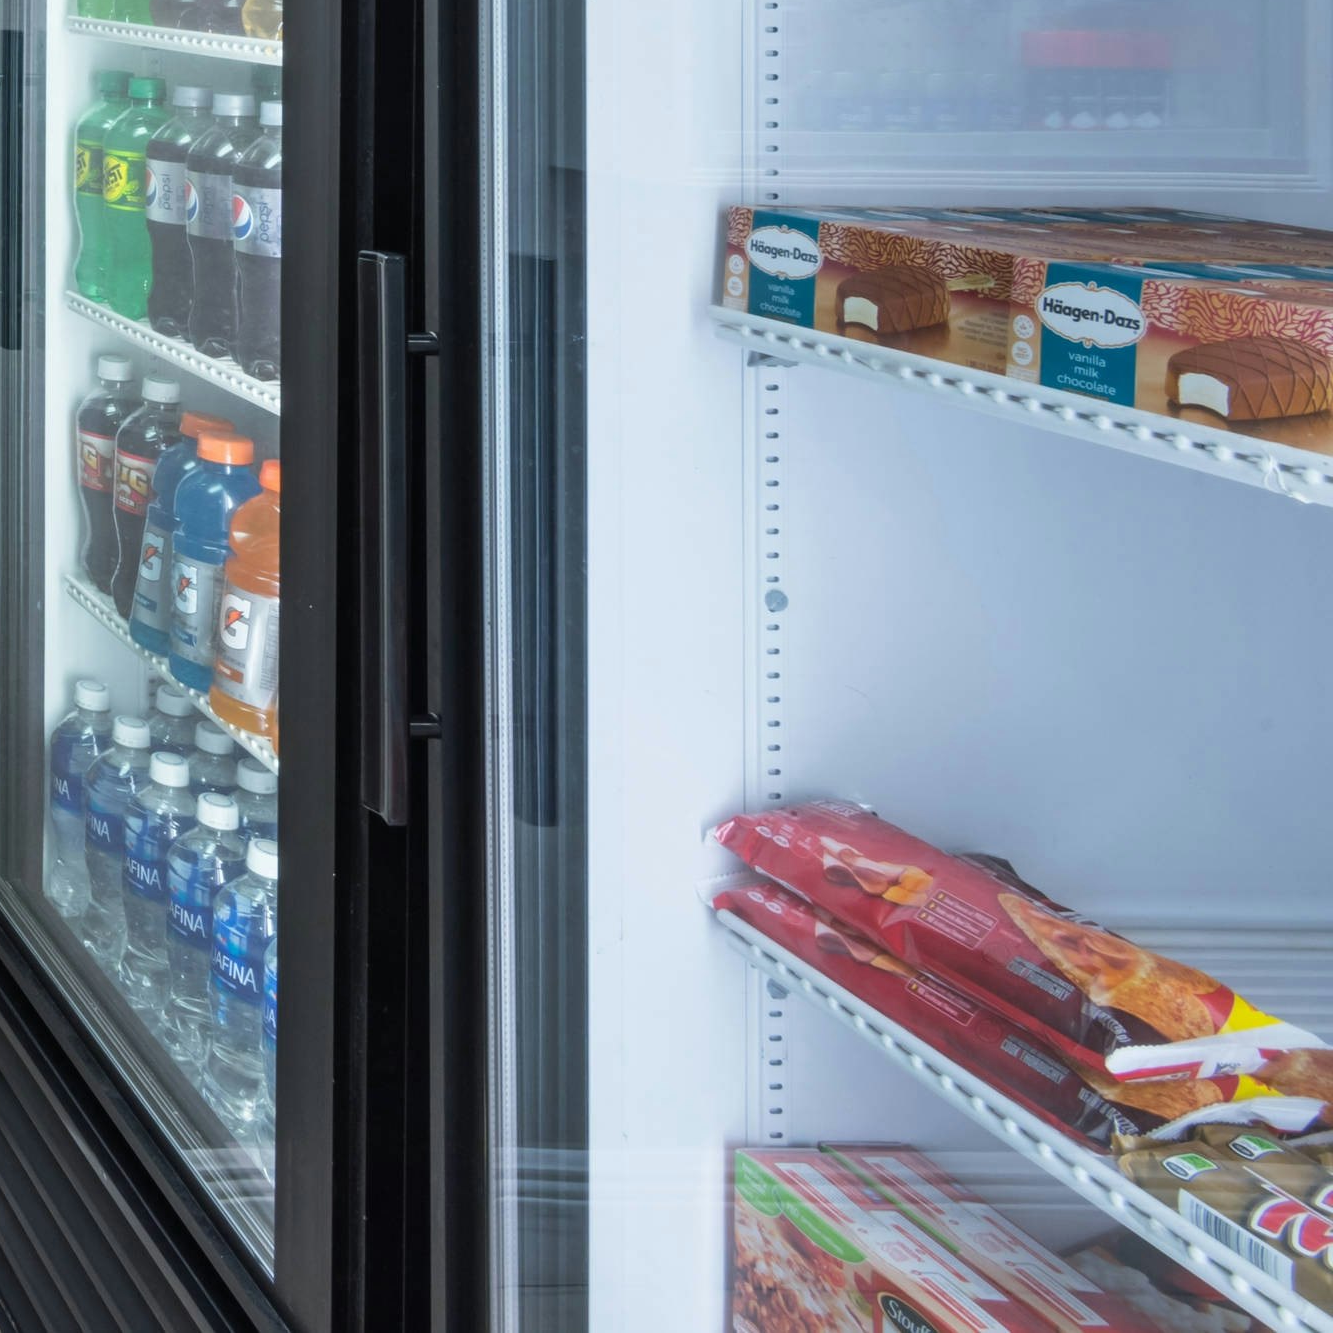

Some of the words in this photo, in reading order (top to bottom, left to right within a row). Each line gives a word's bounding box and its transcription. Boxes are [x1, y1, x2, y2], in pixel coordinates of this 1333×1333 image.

[260, 199, 273, 243] pepsi
[749, 237, 820, 266] Häagen-Dazs
[767, 282, 795, 297] vanilla
[771, 294, 790, 305] milk
[759, 303, 802, 320] chocolate
[1042, 296, 1141, 333] Häagen-Dazs
[1067, 351, 1107, 368] vanilla
[1074, 364, 1099, 378] milk
[1056, 372, 1117, 397] chocolate
[85, 816, 111, 843] FINA
[125, 858, 163, 892] AFINA
[169, 901, 208, 939] AFINA
